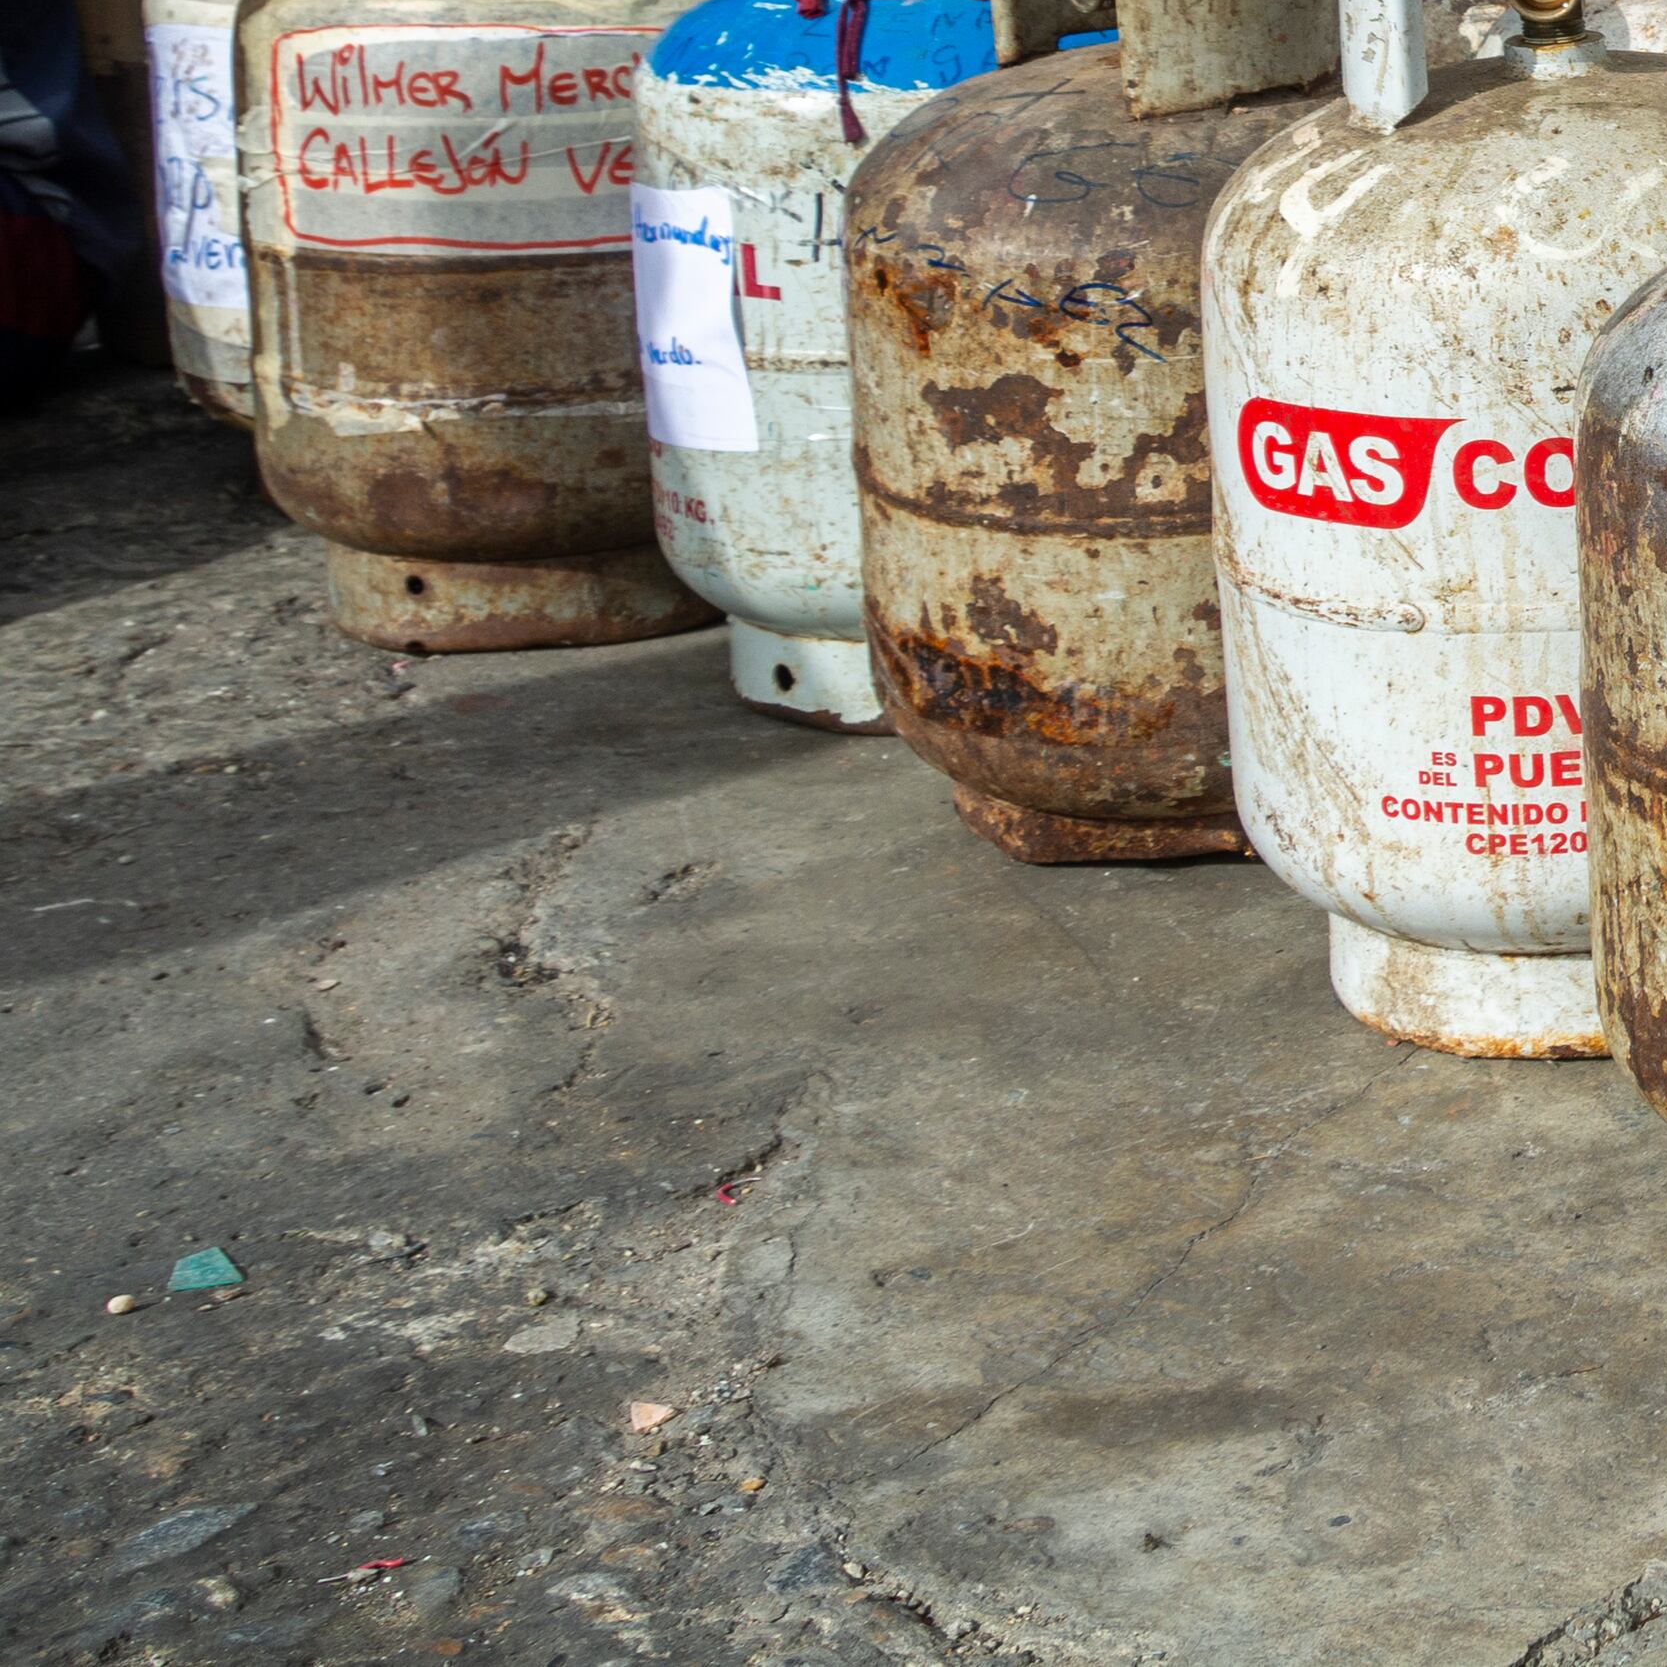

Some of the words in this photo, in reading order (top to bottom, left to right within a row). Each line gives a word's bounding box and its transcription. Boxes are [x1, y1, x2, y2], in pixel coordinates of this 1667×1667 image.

[1252, 421, 1404, 506] GAS
[1452, 435, 1577, 511] CO
[1430, 750, 1458, 767] ES
[1473, 749, 1584, 789] PUE
[1417, 770, 1459, 787] DEL
[1380, 794, 1569, 826] CONTENIDO
